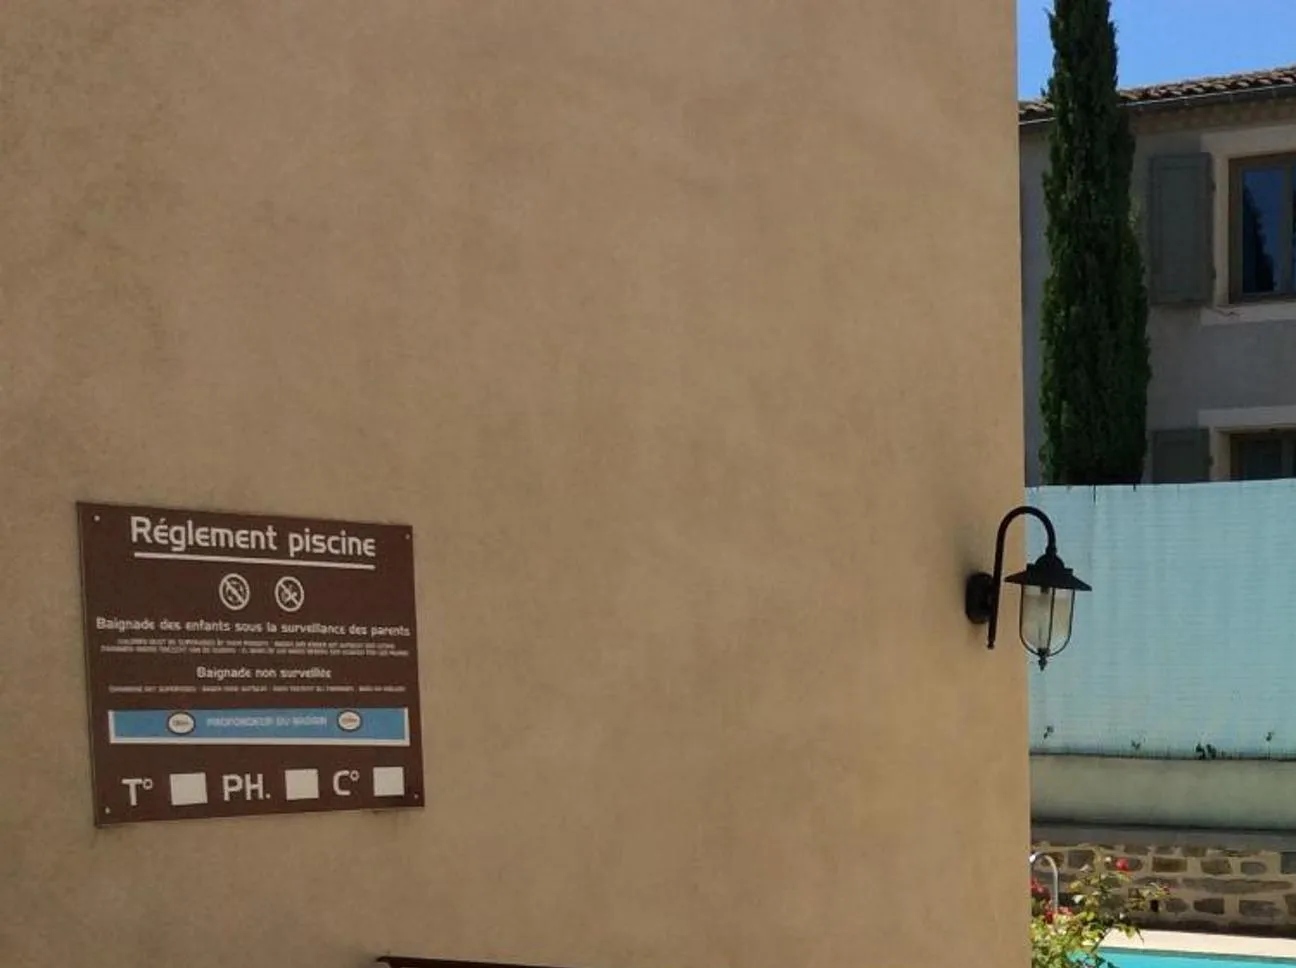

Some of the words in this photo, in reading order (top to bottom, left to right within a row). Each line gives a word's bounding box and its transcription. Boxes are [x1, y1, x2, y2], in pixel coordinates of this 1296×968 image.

[131, 516, 277, 551] Réglement
[288, 528, 376, 557] piscine
[96, 616, 155, 632] Baignade
[160, 618, 181, 631] des
[186, 619, 231, 632] enfants
[235, 622, 263, 633] sous
[267, 622, 277, 633] la
[281, 622, 346, 635] surveillance
[349, 624, 368, 636] des
[371, 625, 411, 638] parents
[196, 666, 251, 681] Baignade
[255, 668, 277, 679] non
[222, 773, 271, 802] PH.
